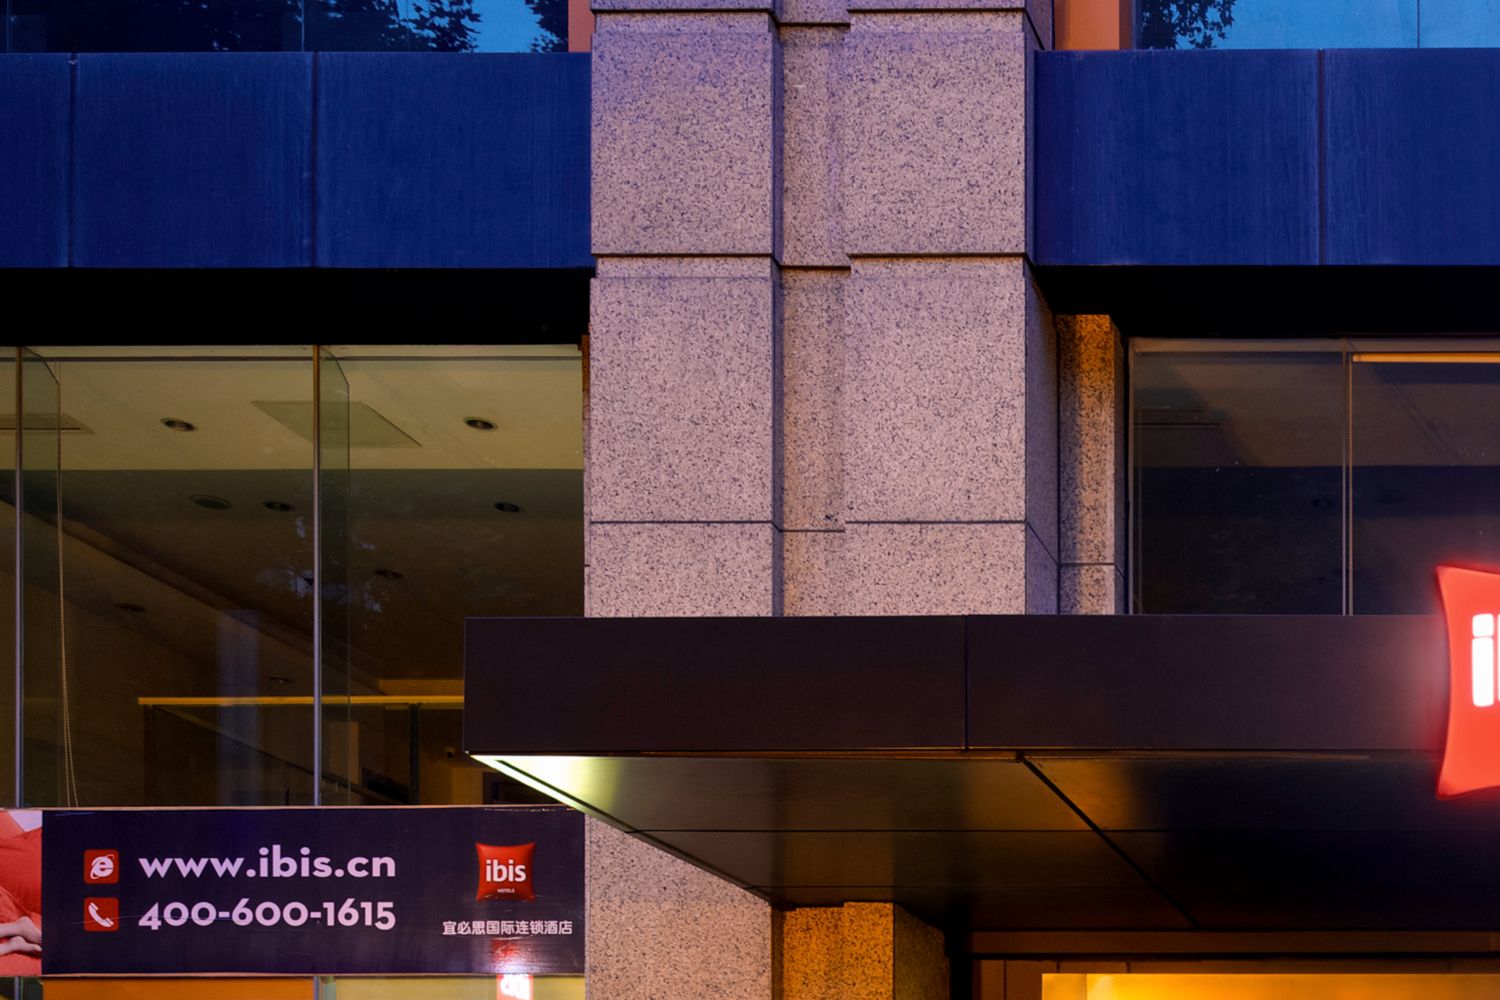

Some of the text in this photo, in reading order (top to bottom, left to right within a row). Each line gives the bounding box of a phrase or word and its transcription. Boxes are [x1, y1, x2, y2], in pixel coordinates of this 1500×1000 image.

[138, 844, 396, 878] www.ibis.cn
[485, 859, 527, 882] ibis
[138, 898, 396, 931] 400-600-1615
[442, 920, 573, 935] 宜必思国际连锁酒店
